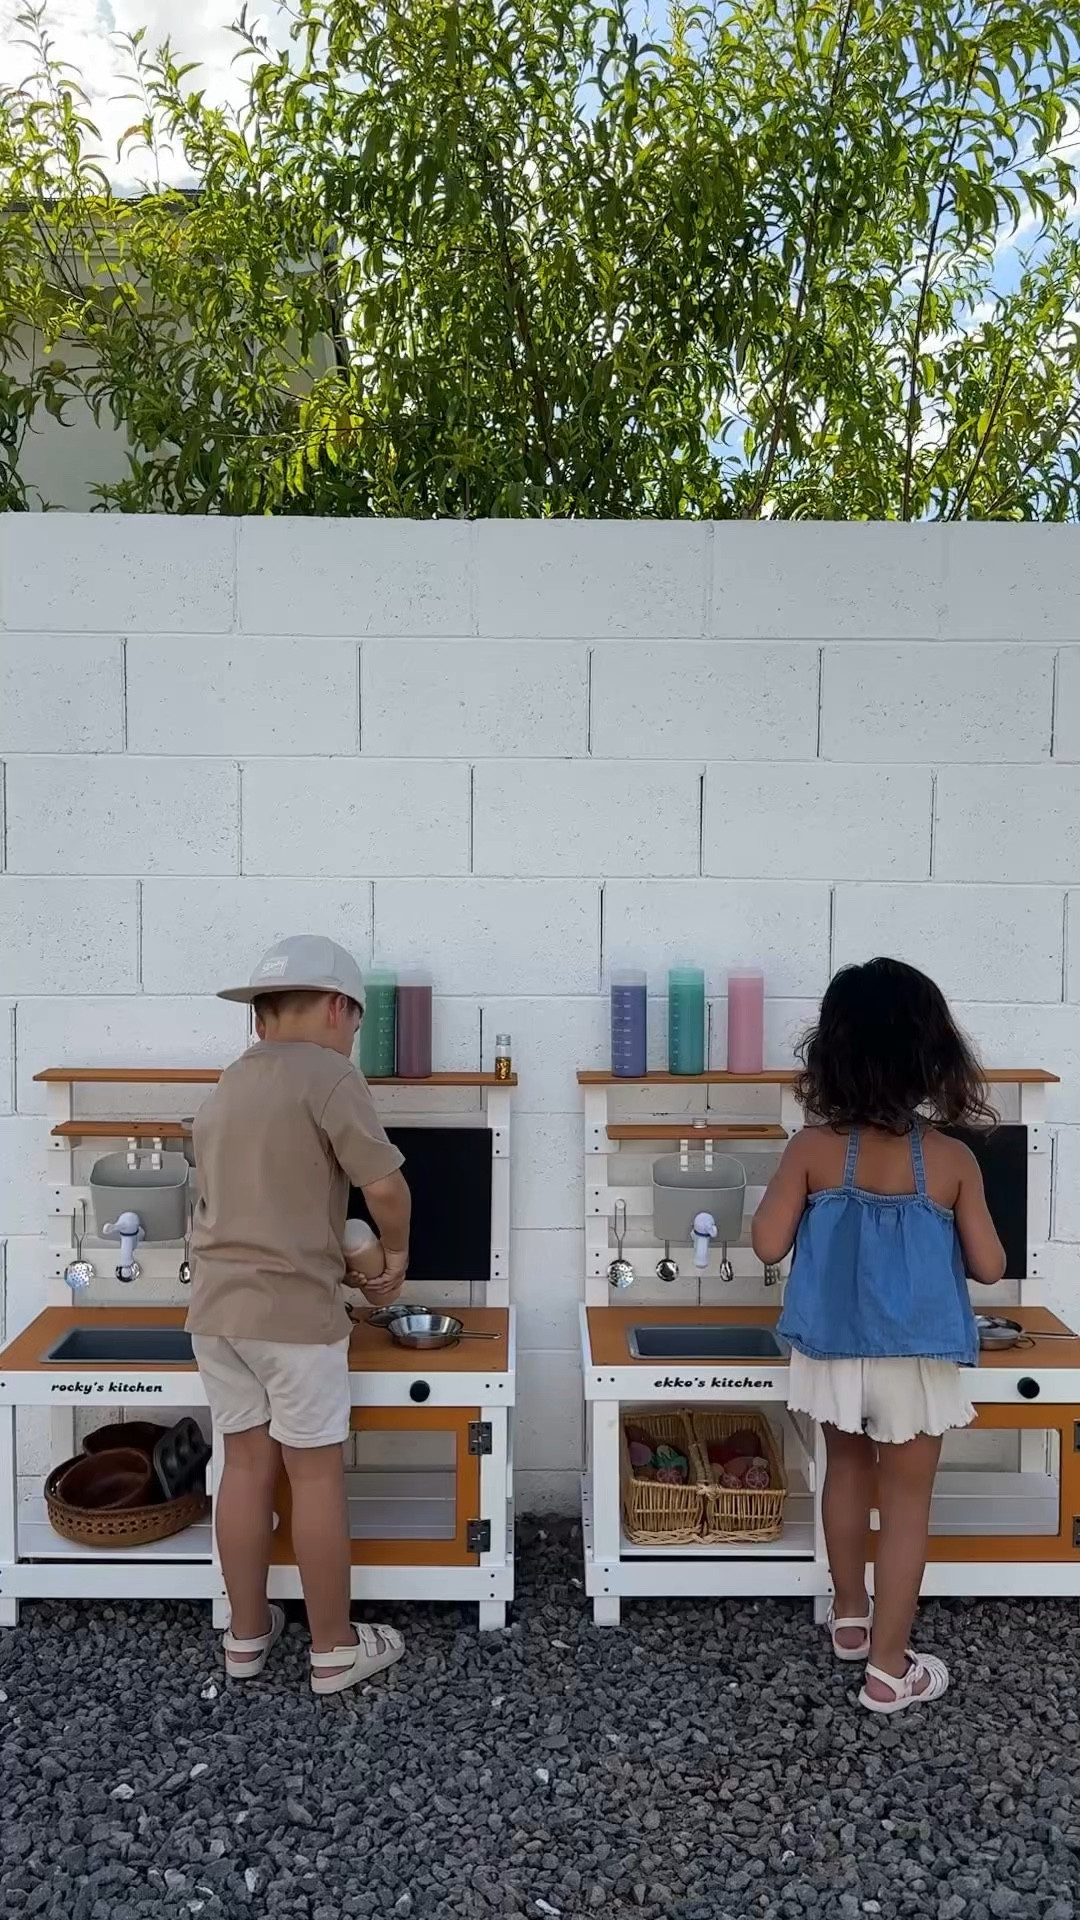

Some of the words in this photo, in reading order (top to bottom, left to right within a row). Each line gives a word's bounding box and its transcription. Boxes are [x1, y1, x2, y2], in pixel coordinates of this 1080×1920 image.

[51, 1381, 105, 1395] rocky's
[108, 1381, 163, 1393] kitchen
[653, 1377, 706, 1388] ekko's
[710, 1377, 773, 1388] kitchen
